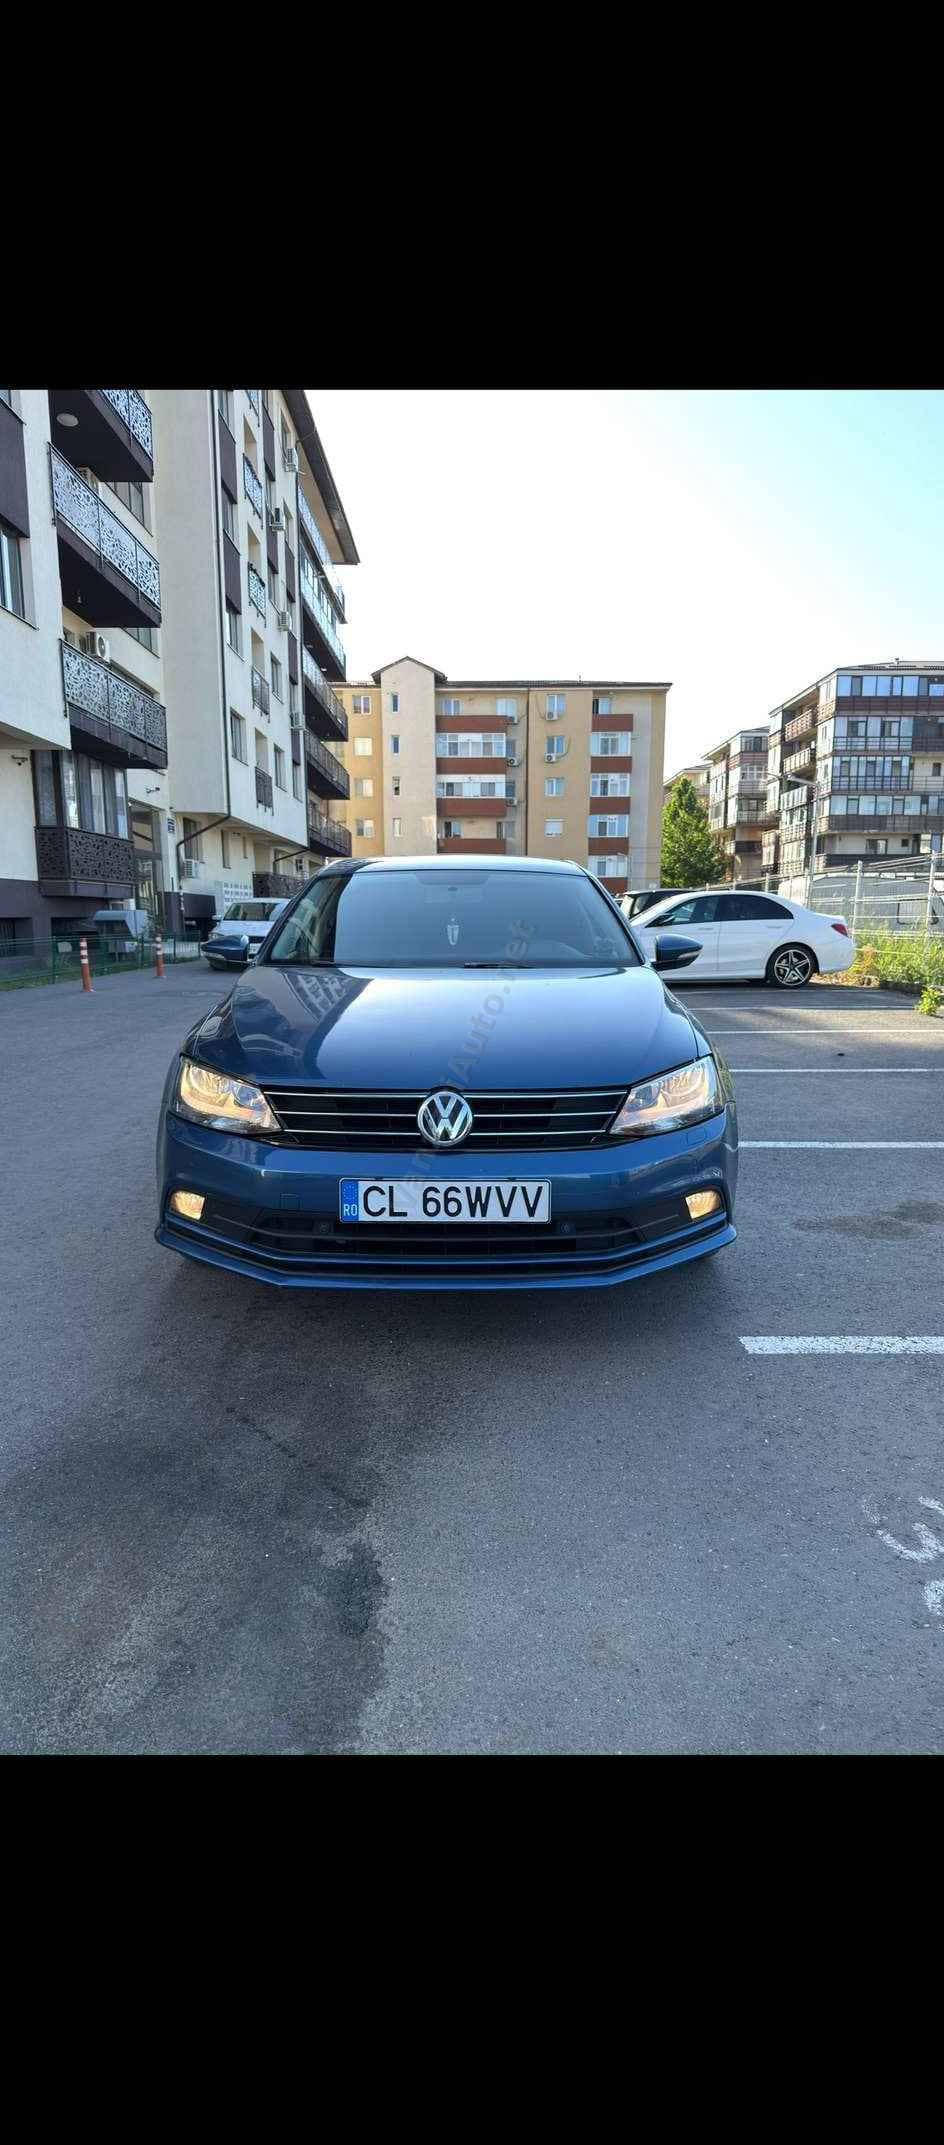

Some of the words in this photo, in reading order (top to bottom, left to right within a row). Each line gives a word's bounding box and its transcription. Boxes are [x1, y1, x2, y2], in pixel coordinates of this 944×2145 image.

[343, 1203, 358, 1217] RO
[363, 1186, 408, 1217] CL
[422, 1186, 543, 1218] 66WVV
